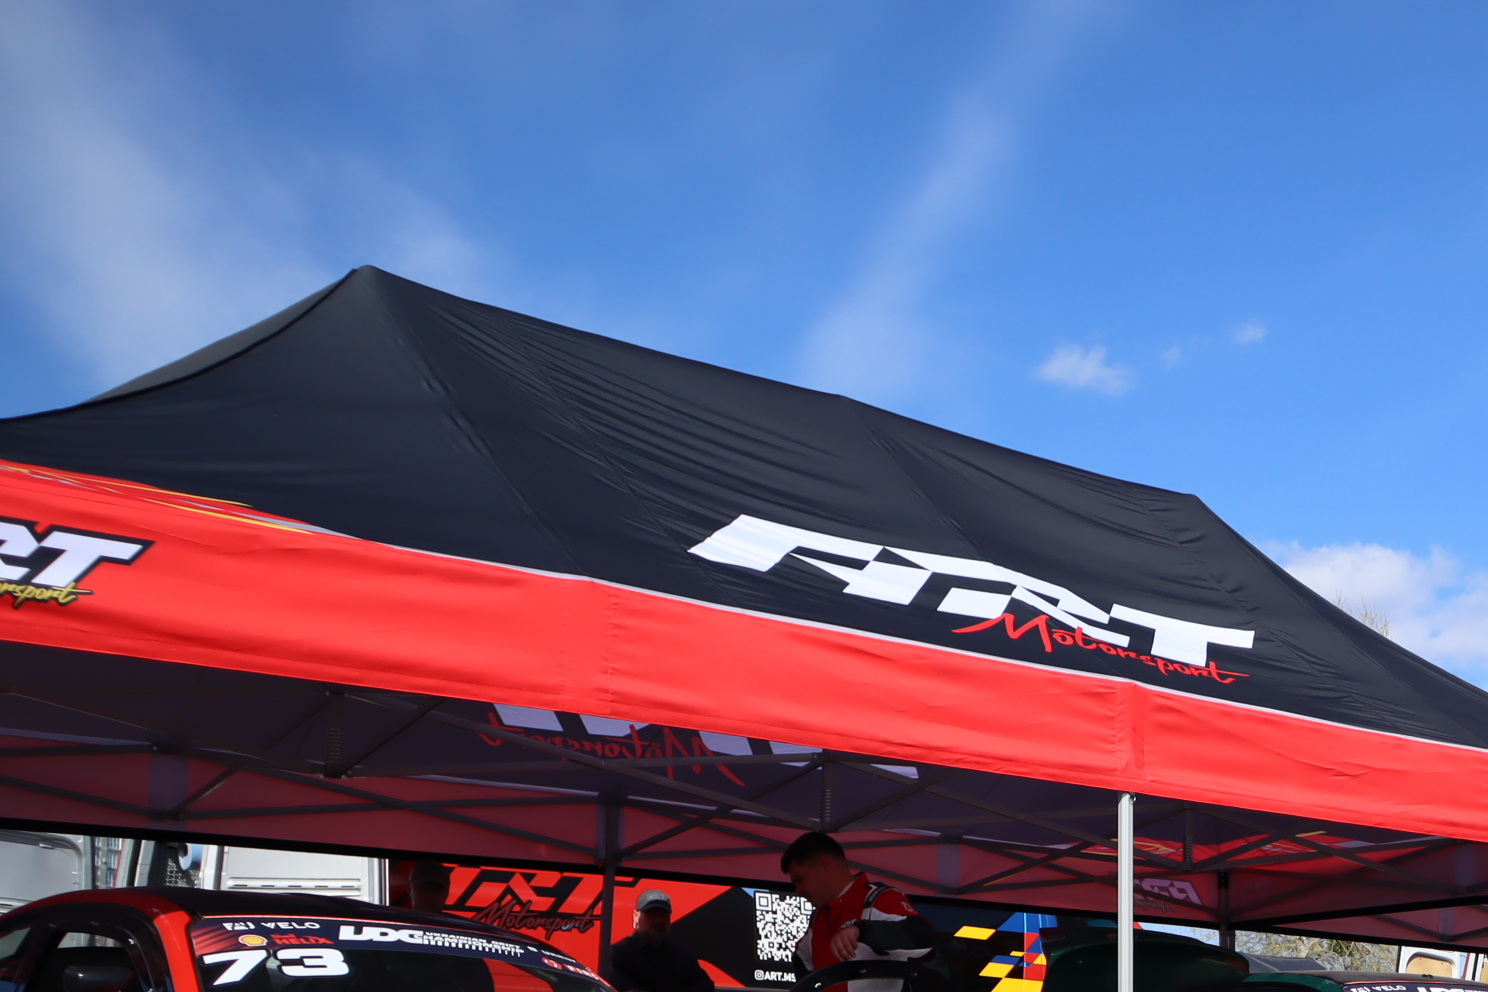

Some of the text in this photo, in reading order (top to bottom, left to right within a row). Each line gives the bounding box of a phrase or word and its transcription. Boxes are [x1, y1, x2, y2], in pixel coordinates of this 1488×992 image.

[951, 612, 1250, 684] Motorsport
[260, 921, 320, 930] VELO
[471, 898, 602, 941] Motorsport
[275, 936, 335, 945] HELIX
[202, 948, 350, 986] 73
